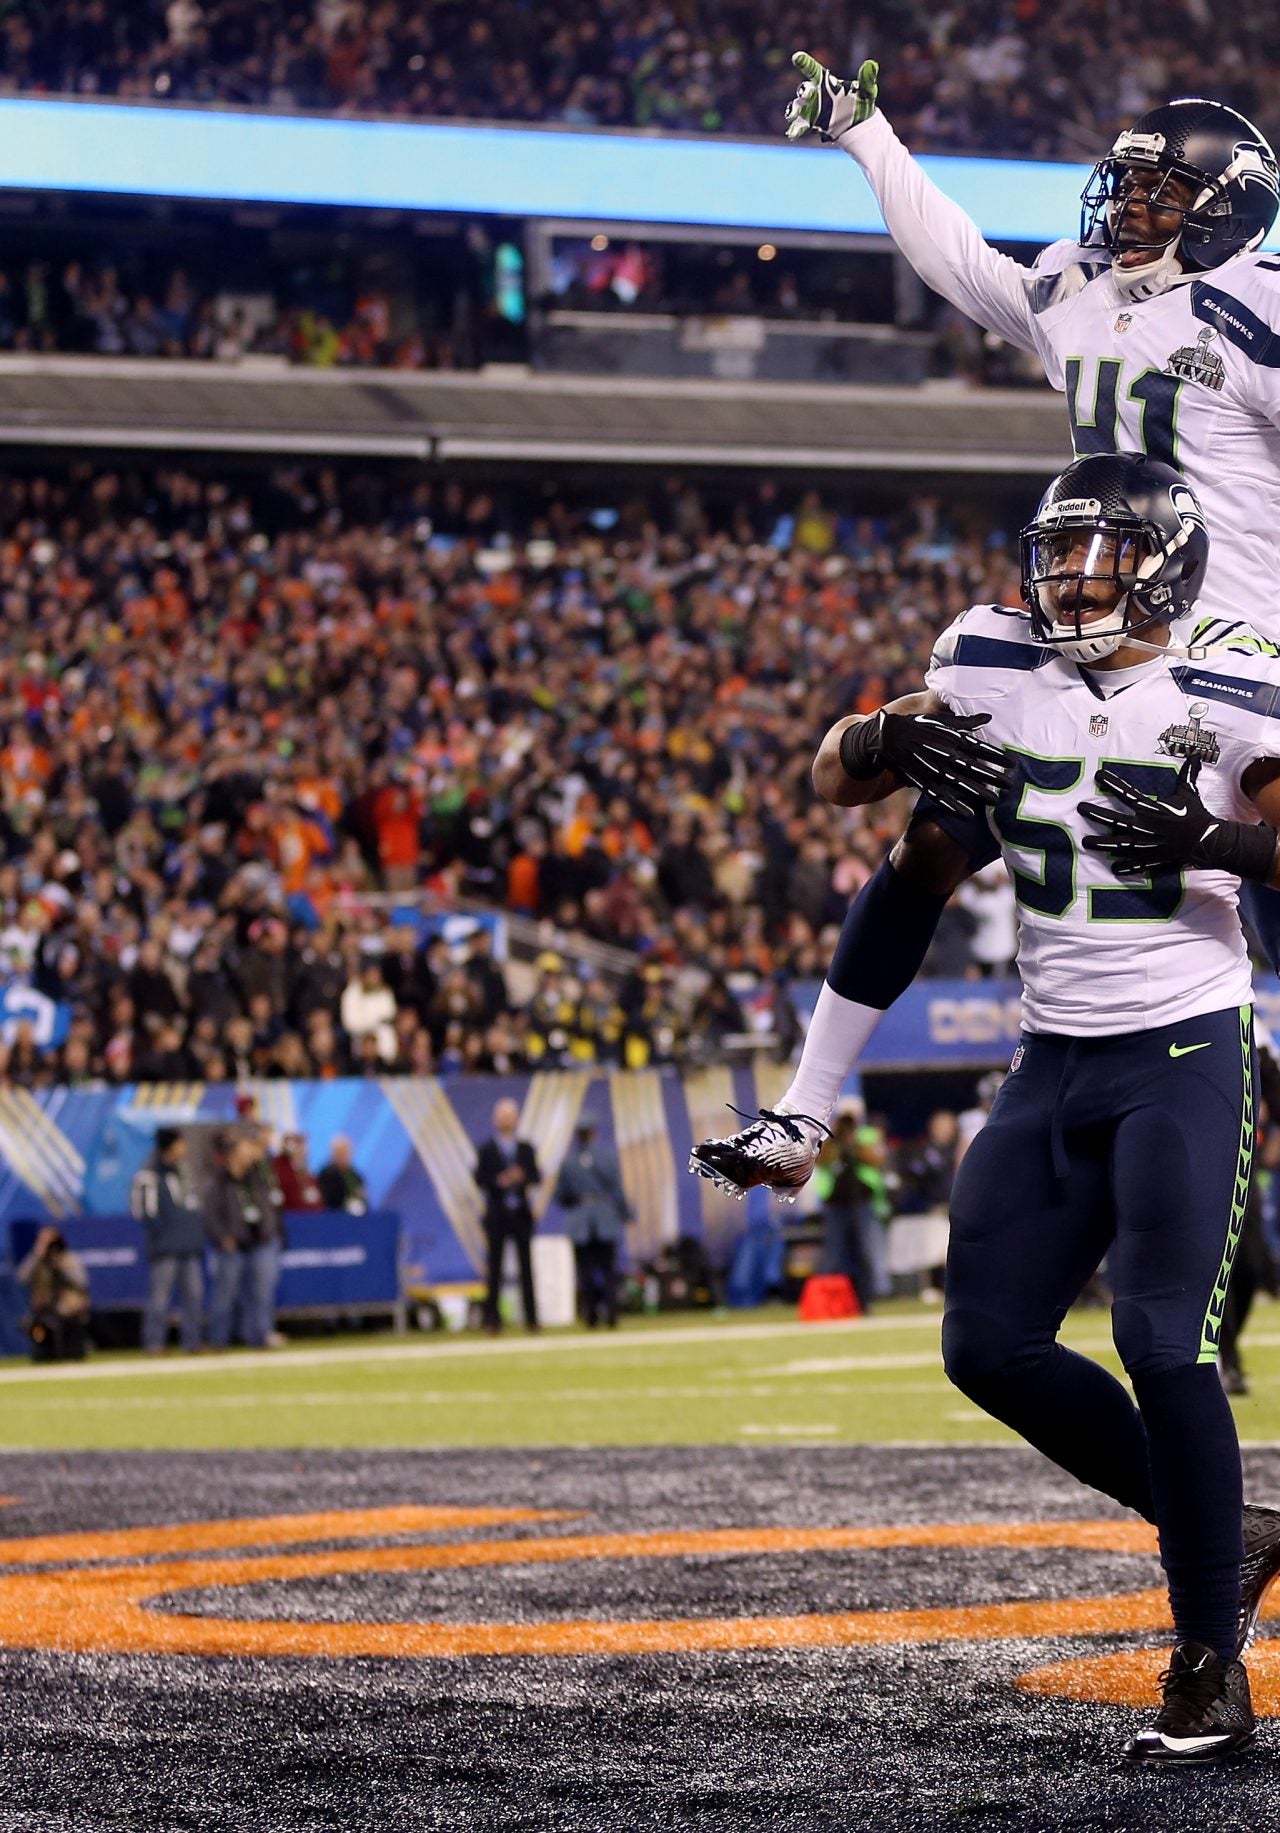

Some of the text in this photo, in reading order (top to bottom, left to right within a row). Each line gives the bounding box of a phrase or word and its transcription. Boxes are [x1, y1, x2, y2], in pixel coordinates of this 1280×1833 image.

[1201, 298, 1255, 341] SEAHAWKS
[1065, 356, 1185, 475] 41
[1057, 501, 1087, 512] Riddell
[1190, 678, 1255, 699] SEAHAWKS
